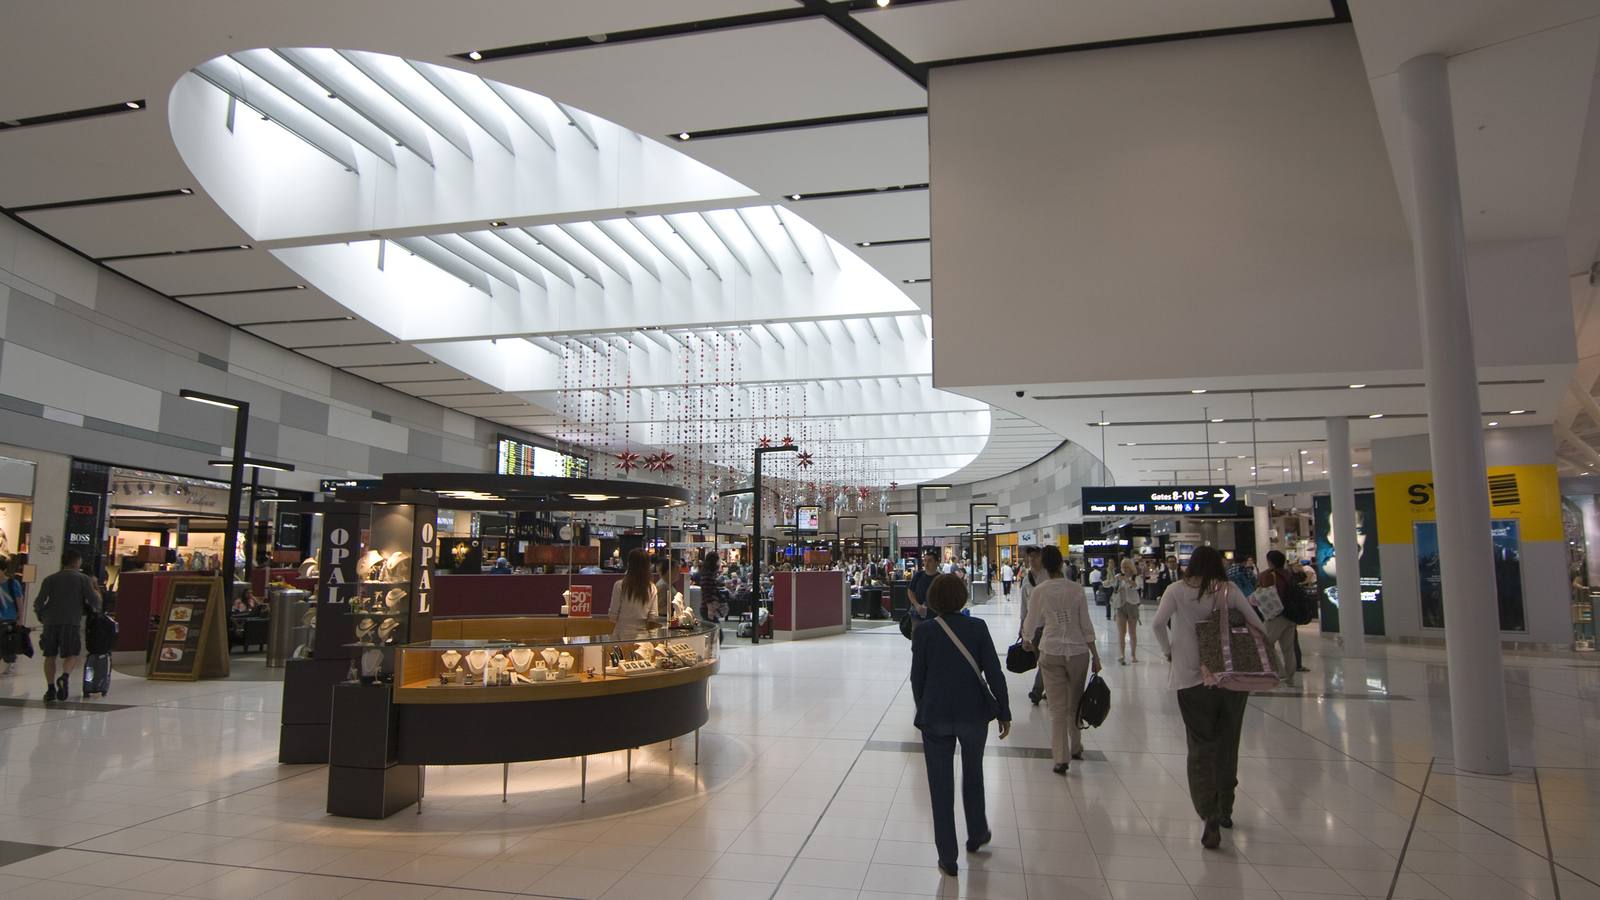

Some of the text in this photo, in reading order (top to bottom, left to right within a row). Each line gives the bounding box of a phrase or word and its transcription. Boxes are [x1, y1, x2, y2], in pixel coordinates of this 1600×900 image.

[1151, 491, 1195, 501] Gates 8-10
[1408, 483, 1434, 505] S
[70, 532, 90, 542] BOSS
[327, 527, 350, 604] OPAL
[419, 522, 435, 614] OPAL
[571, 603, 590, 613] off!
